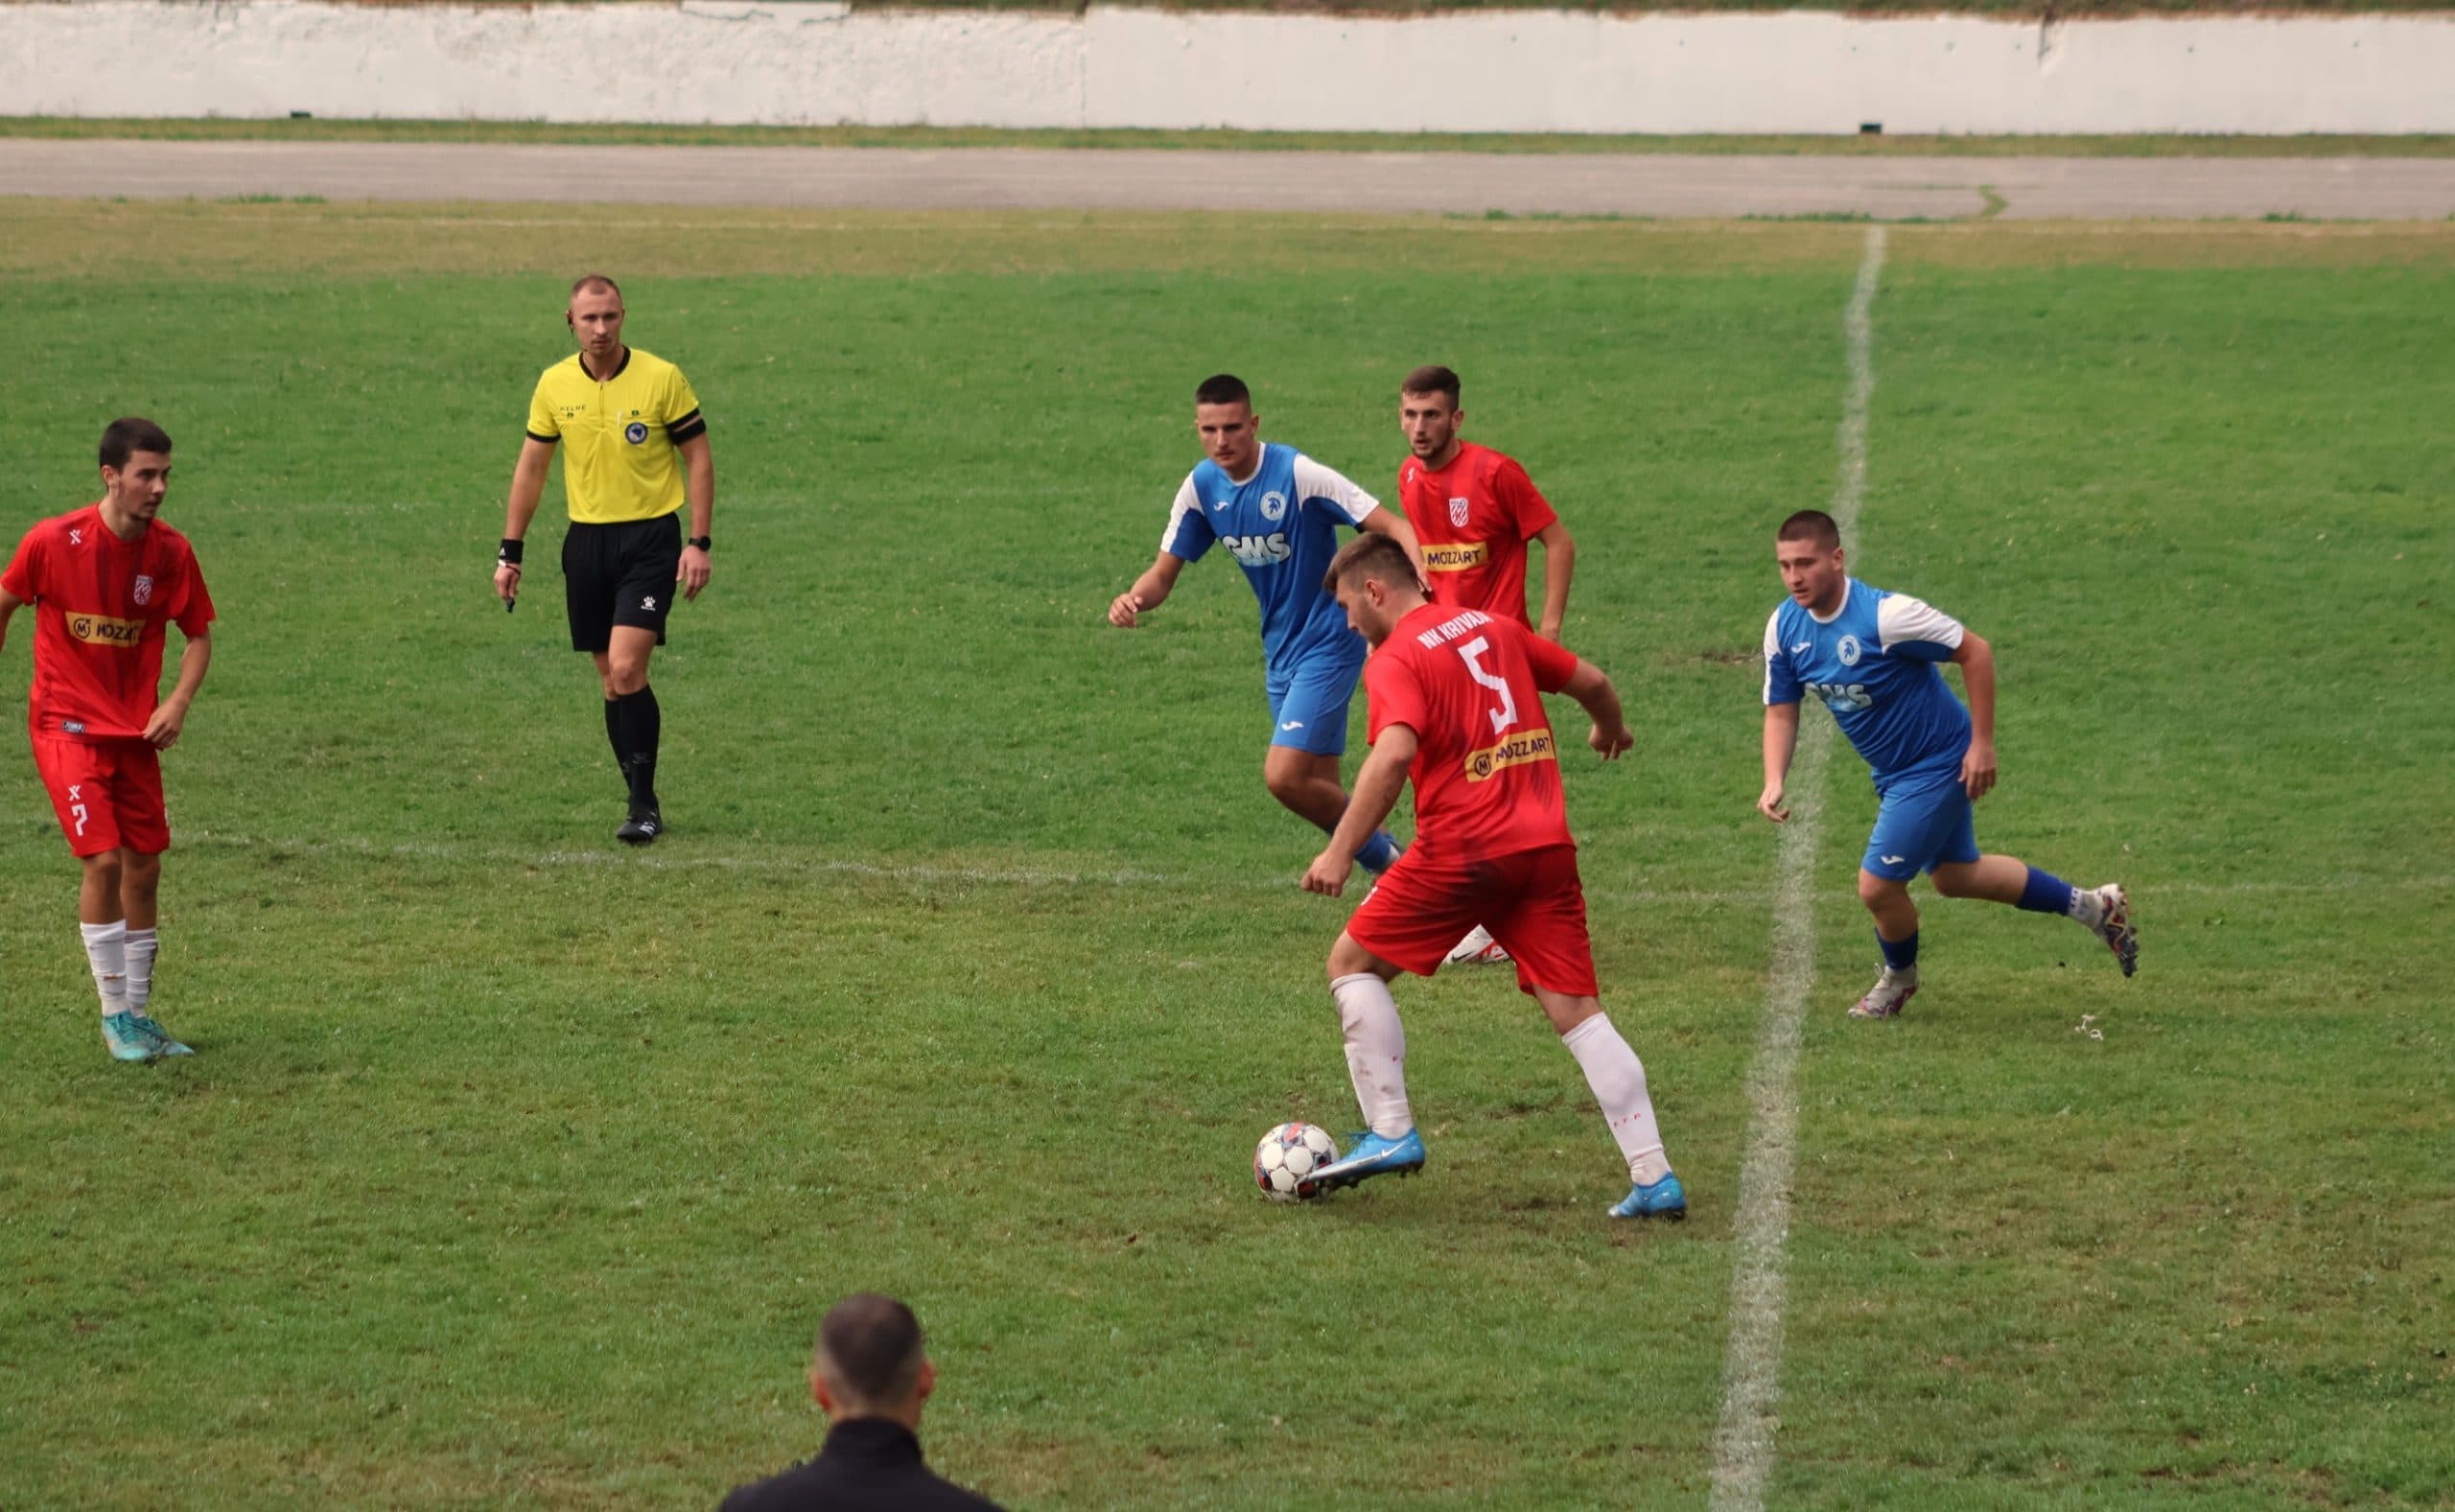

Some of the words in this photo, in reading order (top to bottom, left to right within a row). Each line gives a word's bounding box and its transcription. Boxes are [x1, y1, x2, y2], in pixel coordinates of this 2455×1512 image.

[1427, 550, 1480, 566] MOZZART
[1417, 629, 1445, 650] NK
[1458, 636, 1518, 735] 5
[1496, 737, 1550, 763] MOZZART
[71, 803, 88, 836] 7
